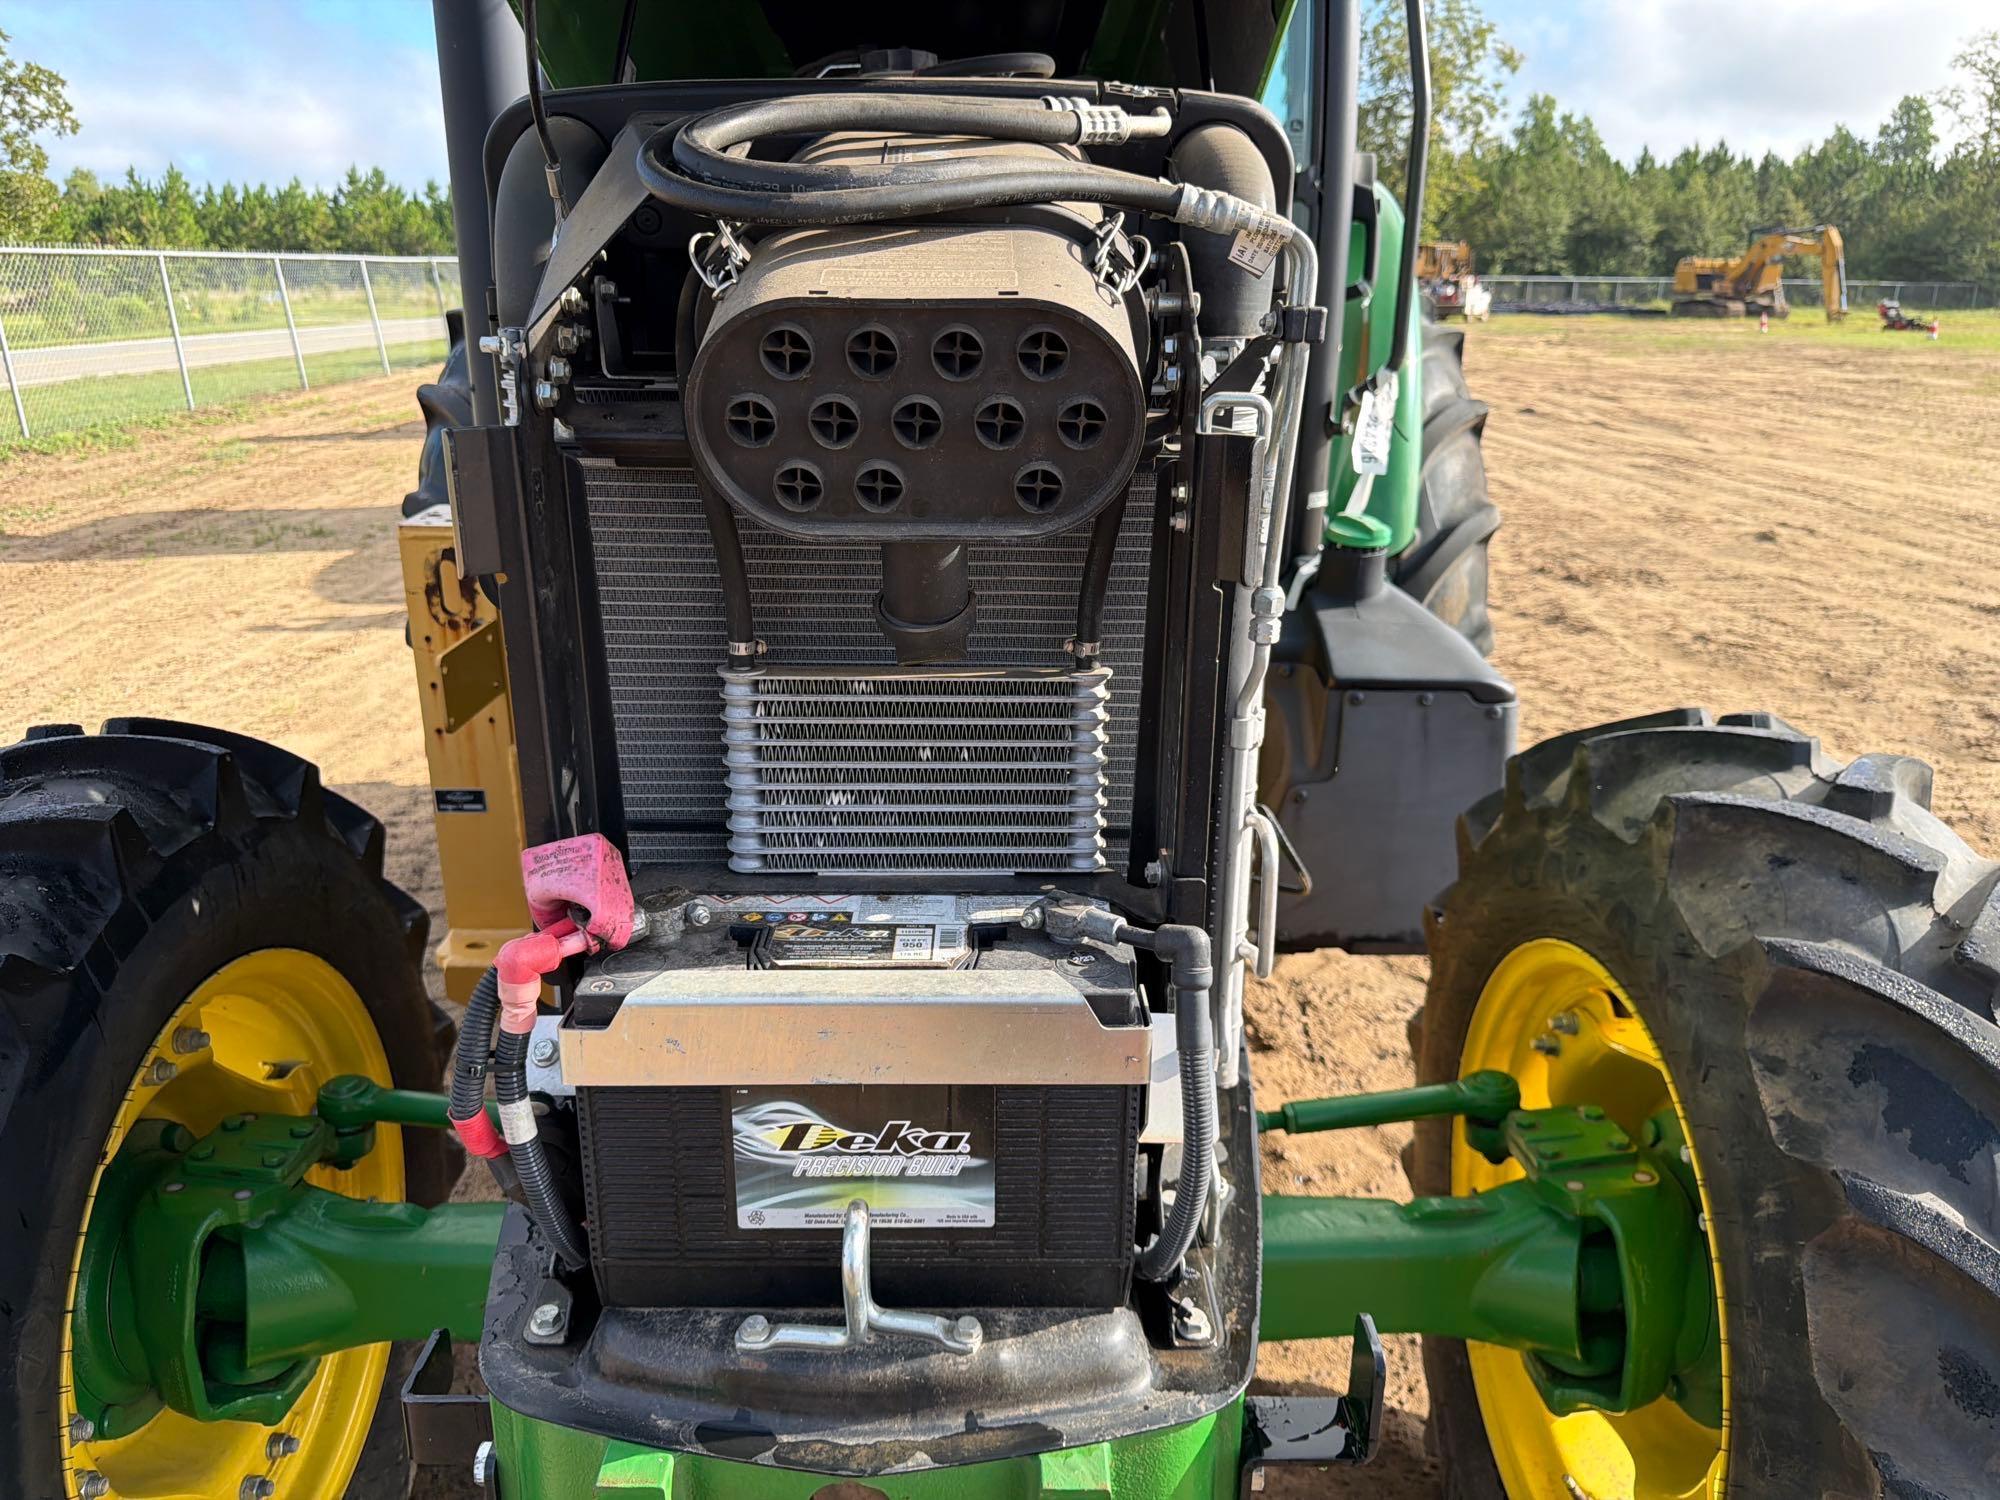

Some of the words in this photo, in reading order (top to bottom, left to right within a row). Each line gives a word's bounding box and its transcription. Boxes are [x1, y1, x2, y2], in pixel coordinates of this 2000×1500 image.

[775, 1120, 971, 1157] Deka
[792, 1156, 906, 1177] PRECISION
[905, 1155, 970, 1177] BUILT
